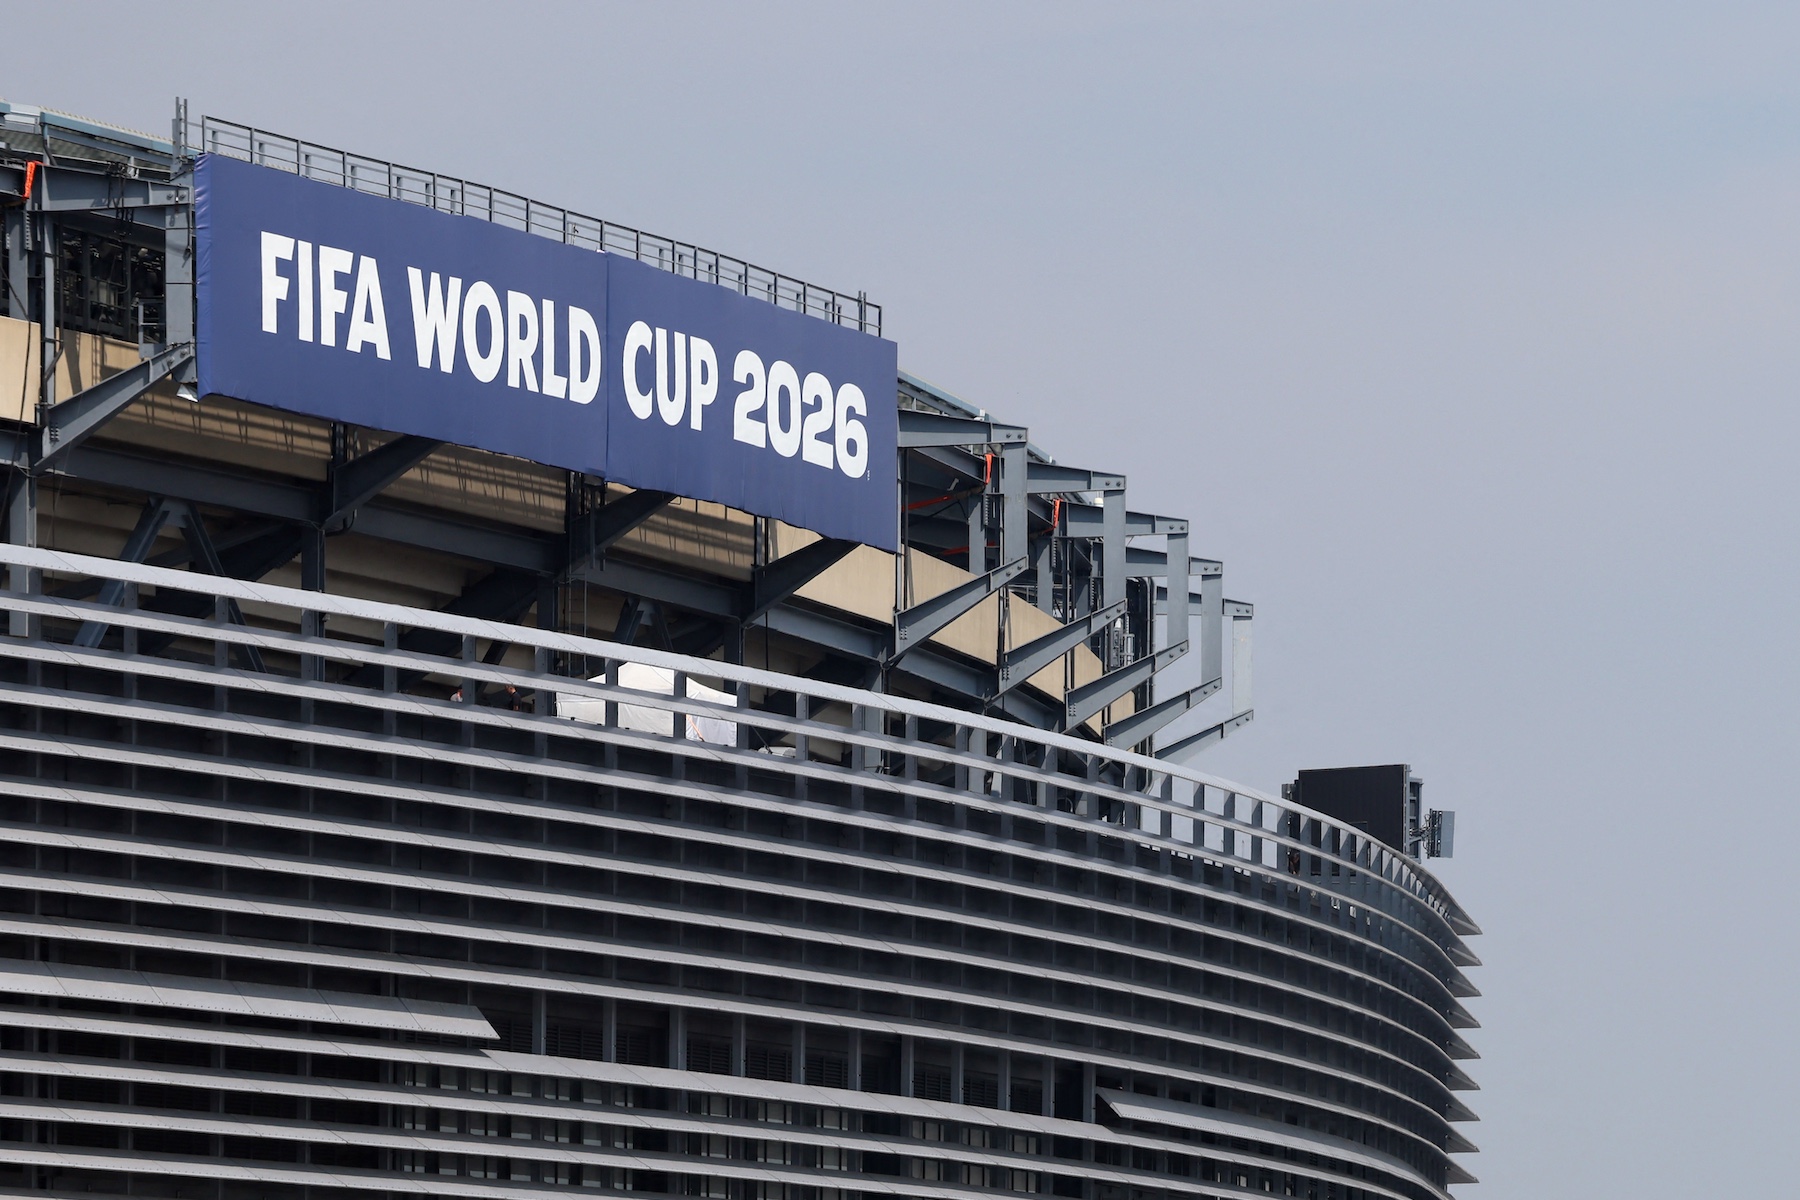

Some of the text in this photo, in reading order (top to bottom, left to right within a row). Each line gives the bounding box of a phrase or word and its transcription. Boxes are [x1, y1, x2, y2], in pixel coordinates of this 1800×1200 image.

[260, 231, 868, 479] FIFA WORLD CUP 2026
